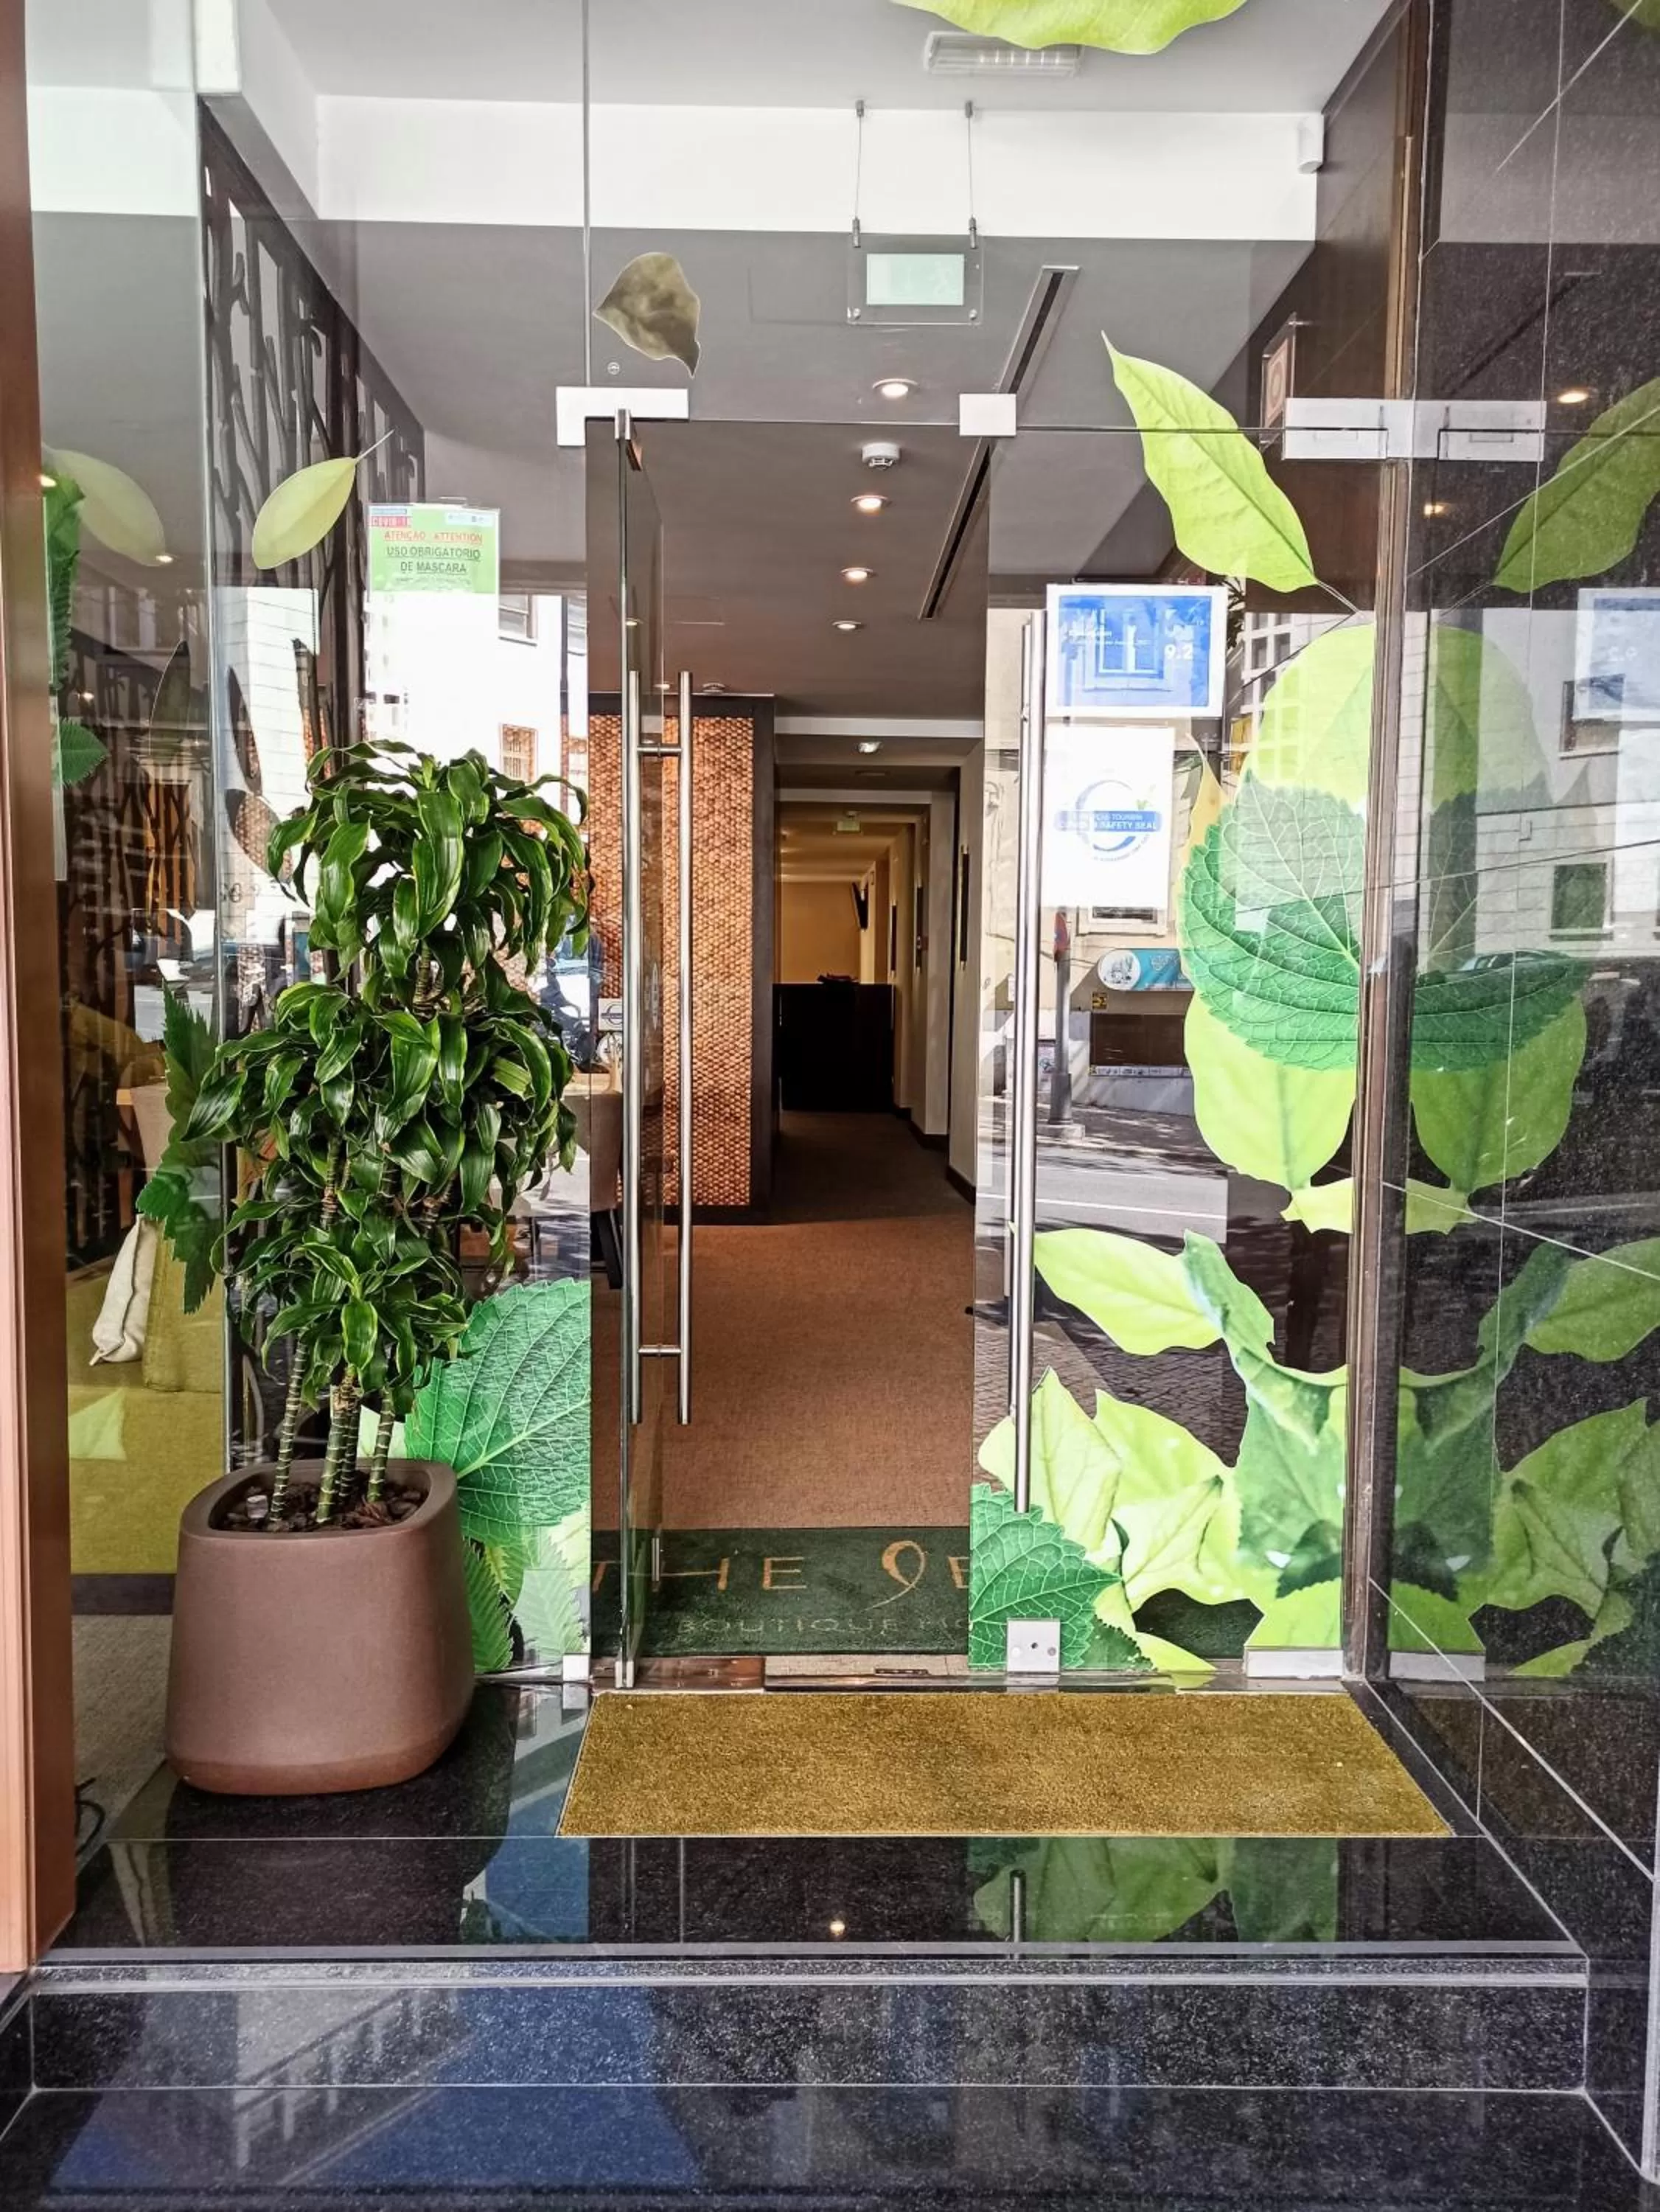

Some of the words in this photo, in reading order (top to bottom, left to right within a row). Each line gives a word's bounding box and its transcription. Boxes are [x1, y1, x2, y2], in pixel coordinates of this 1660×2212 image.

[386, 546, 408, 556] USO
[400, 560, 414, 572] DE
[1164, 644, 1193, 661] 9.2
